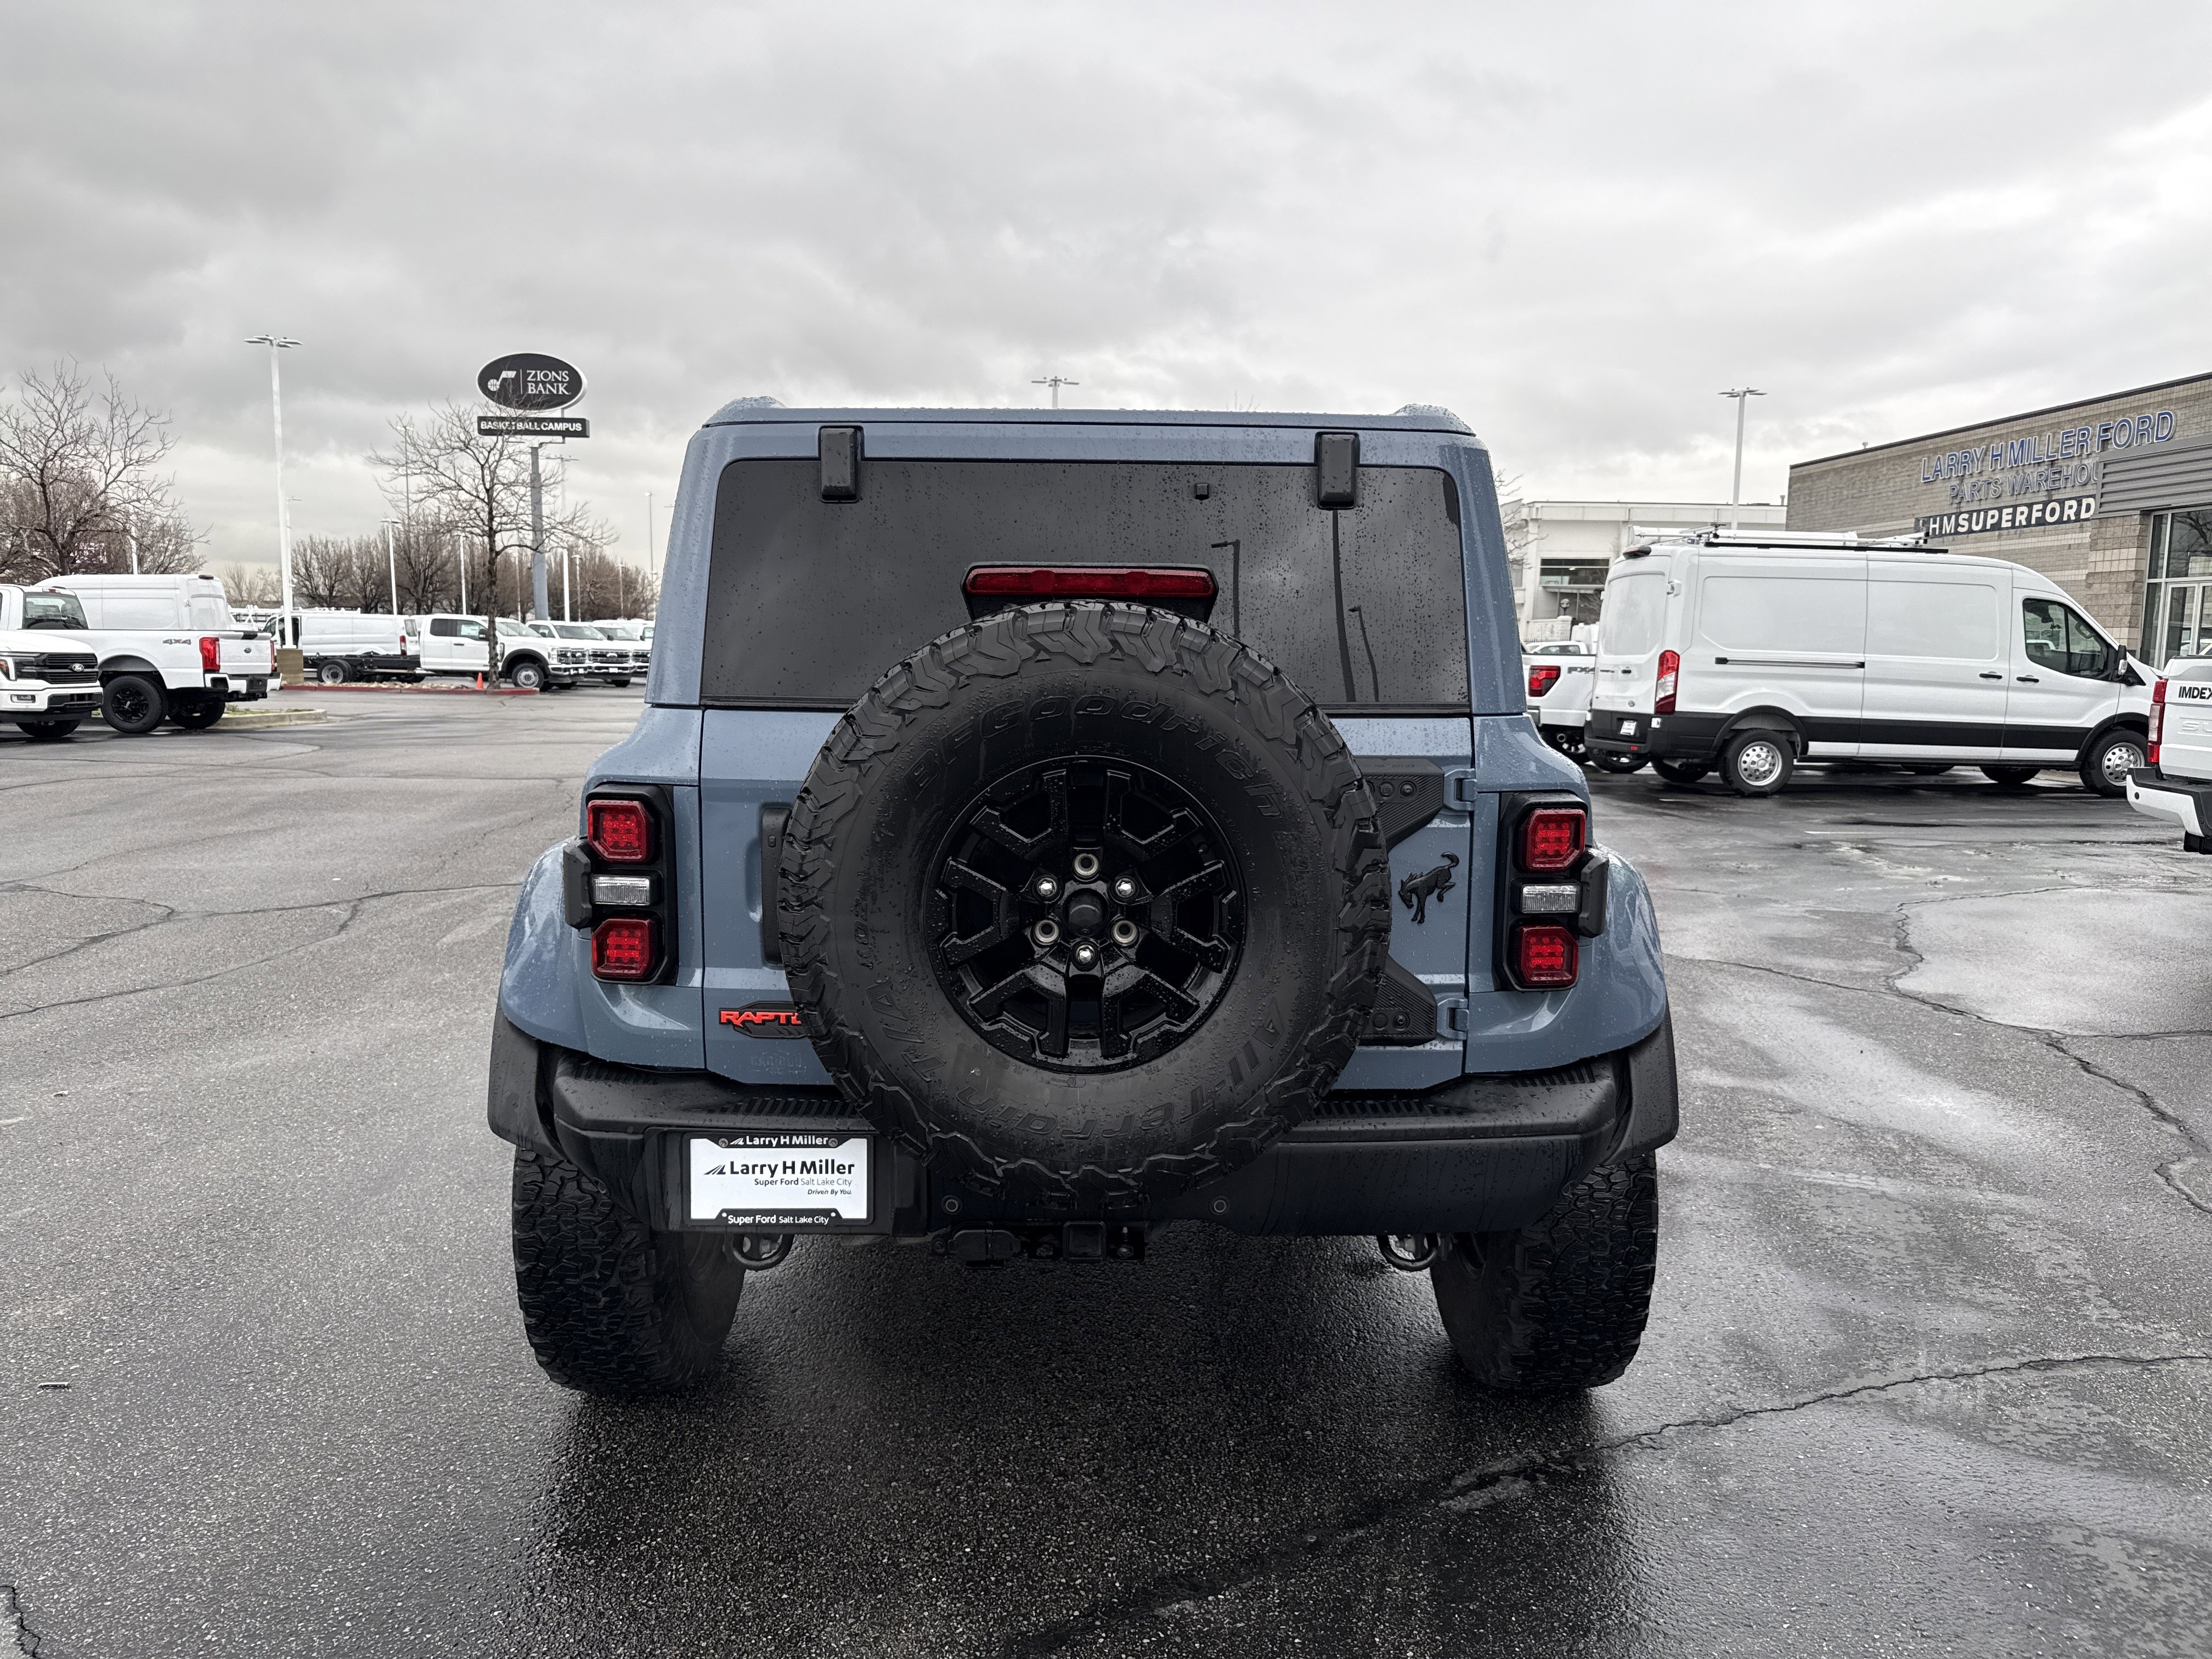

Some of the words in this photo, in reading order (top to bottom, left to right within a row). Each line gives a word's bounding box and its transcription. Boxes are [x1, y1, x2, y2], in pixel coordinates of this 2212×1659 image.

[526, 369, 569, 382] ZIONS
[527, 383, 569, 395] BANK
[541, 422, 582, 432] CAMPUS
[1921, 445, 1987, 483] LARRY
[1989, 443, 2004, 471] H
[2007, 426, 2092, 468] MILLER
[2096, 410, 2175, 453] FORD
[1949, 477, 2003, 504] PARTS
[1919, 497, 2096, 535] HMSUPERFORD
[902, 695, 1282, 817] BFGoodrich
[746, 1135, 779, 1147] Larry
[780, 1136, 789, 1145] H
[792, 1135, 829, 1146] Miller
[730, 1160, 778, 1178] Larry
[783, 1160, 795, 1175] H
[800, 1159, 855, 1175] Miller
[754, 1178, 778, 1187] Super
[837, 1178, 853, 1187] City
[728, 1215, 754, 1225] Super
[755, 1215, 776, 1223] Ford
[778, 1215, 794, 1223] Salt
[795, 1215, 813, 1224] Lake
[814, 1215, 830, 1225] City
